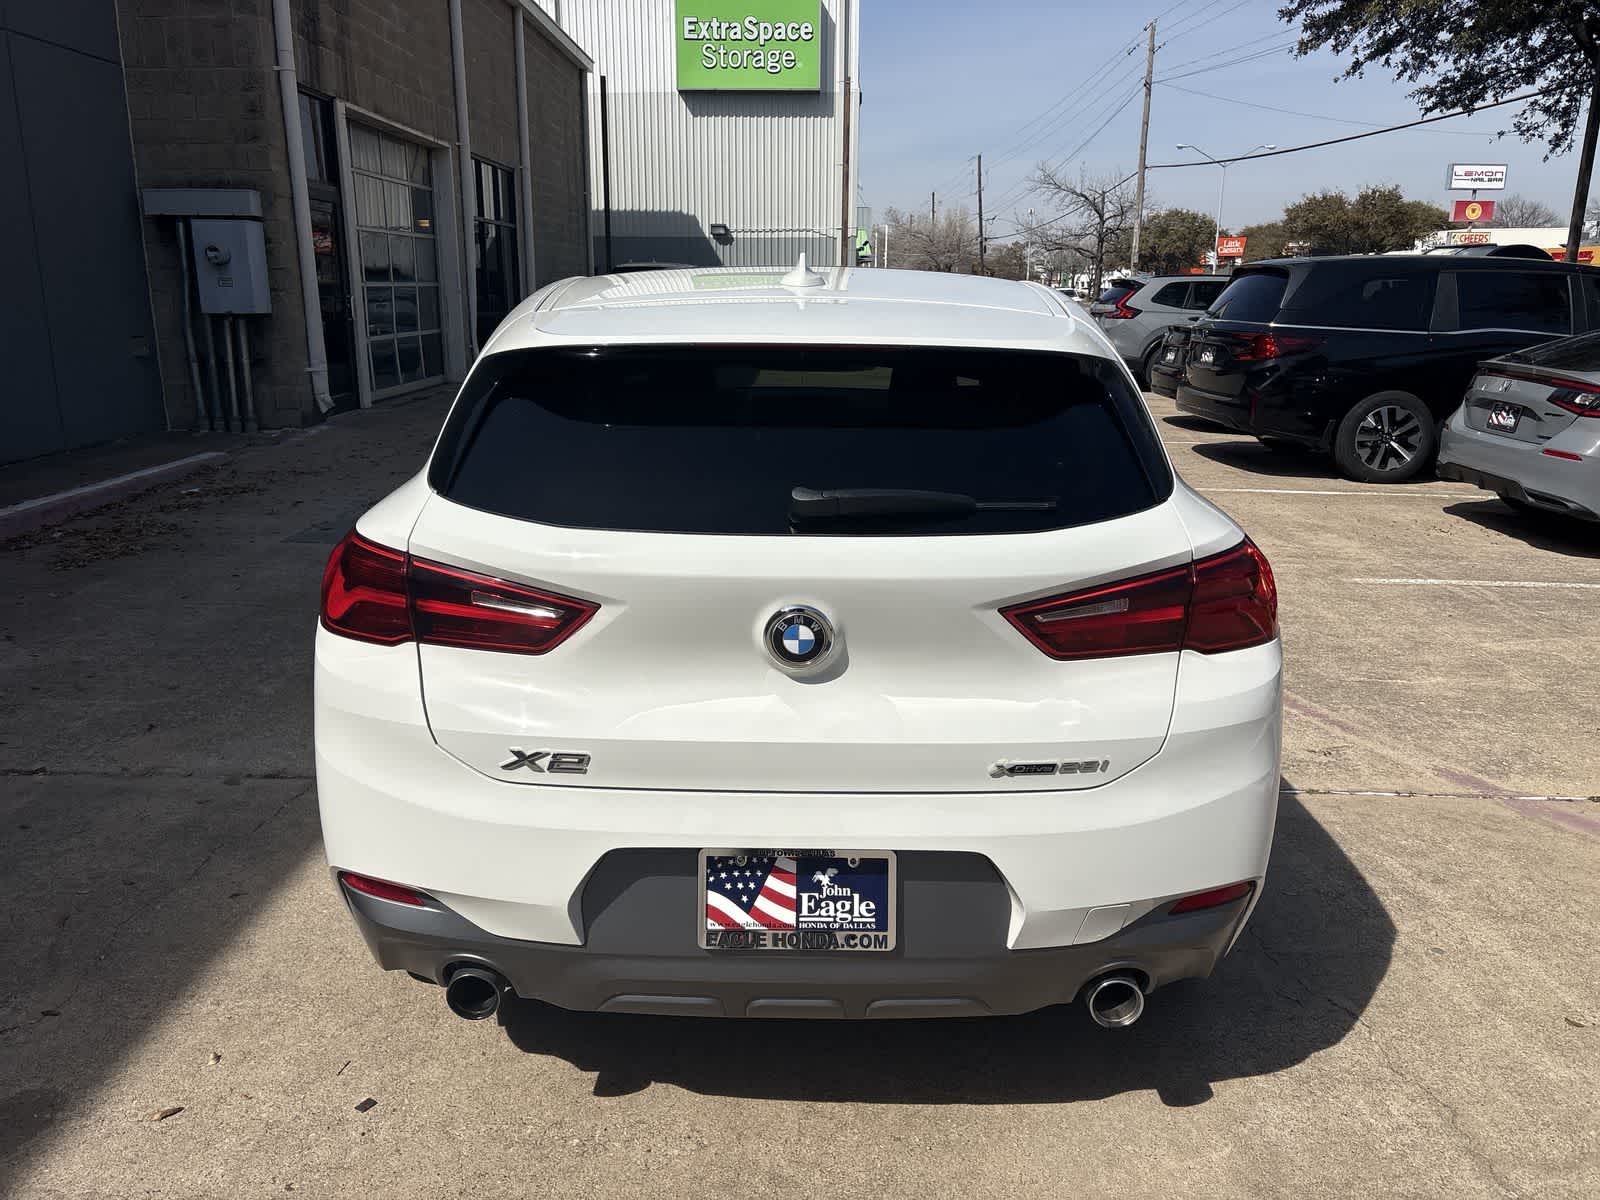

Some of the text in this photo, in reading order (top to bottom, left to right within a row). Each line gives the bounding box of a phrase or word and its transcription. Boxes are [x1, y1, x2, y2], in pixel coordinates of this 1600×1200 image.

[702, 43, 796, 73] Storage
[1459, 233, 1489, 244] CHEERS
[778, 615, 821, 632] BMW
[500, 748, 591, 775] X2
[820, 884, 851, 898] John
[799, 892, 876, 923] Eagle
[799, 922, 876, 930] HONDA OF DALLAS
[706, 931, 768, 949] EAGLE
